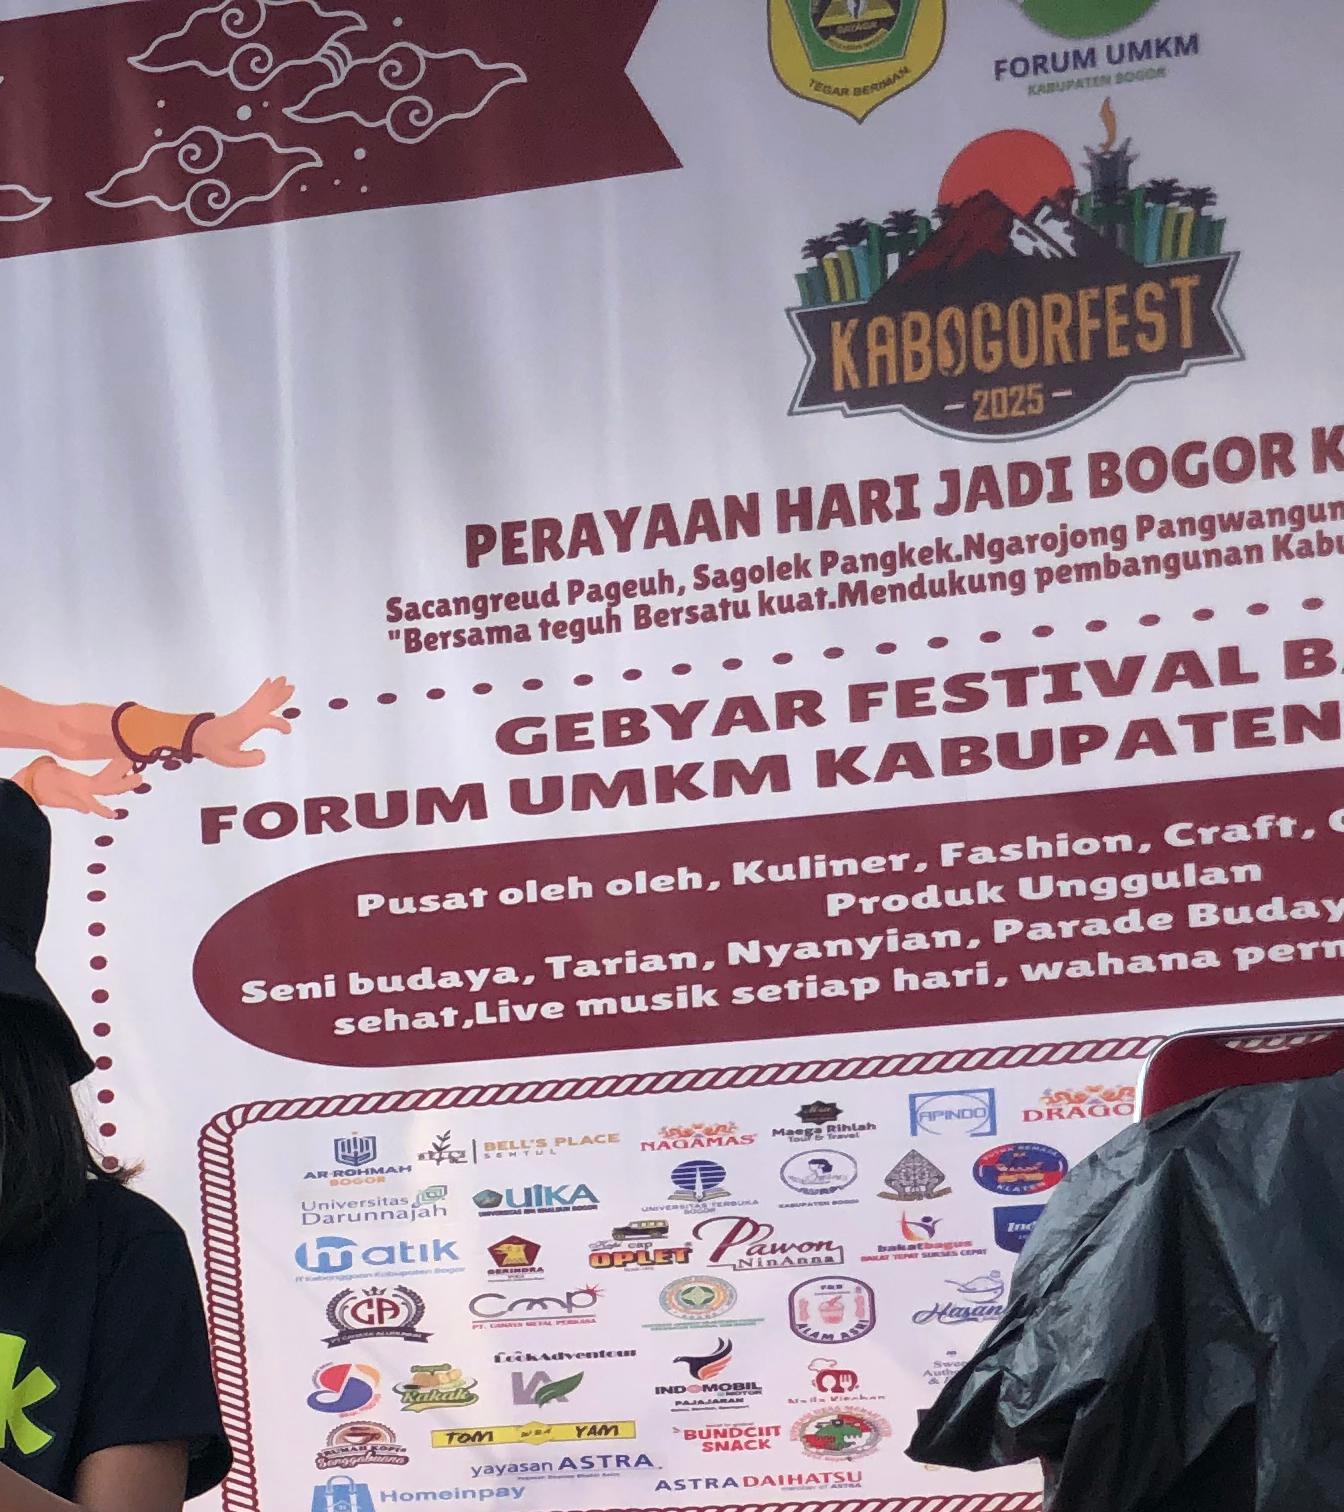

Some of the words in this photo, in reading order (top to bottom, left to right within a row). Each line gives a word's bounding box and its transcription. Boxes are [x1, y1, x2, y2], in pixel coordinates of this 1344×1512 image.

[993, 46, 1097, 81] FORUM
[1110, 33, 1200, 67] UMKM
[809, 78, 850, 97] TEGAR
[852, 66, 910, 97] BERIMAN
[1027, 76, 1110, 97] KABUPATEN
[1114, 67, 1166, 87] BOGOR
[830, 275, 1201, 392] KABOGORFEST
[972, 383, 1045, 422] 2025
[465, 492, 761, 568] PERAYAAN
[775, 473, 920, 534] HARI
[933, 456, 1073, 516] JADI
[1088, 432, 1297, 498] BOGOR
[385, 581, 558, 624] Sacangreud
[566, 568, 686, 607] Pageuh,
[693, 552, 813, 592] Sagolek
[819, 522, 1127, 578] Pangkek.Ngarojong
[388, 620, 531, 654] "Bersama
[539, 608, 622, 644] teguh
[634, 597, 752, 631] Bersatu
[758, 566, 1026, 617] kuat.Mendukung
[1034, 539, 1265, 593] pembangunan
[495, 688, 826, 756] GEBYAR
[848, 646, 1260, 723] FESTIVAL
[1283, 637, 1344, 681] B
[200, 783, 488, 845] FORUM
[510, 754, 792, 815] UMKM
[816, 700, 1343, 788] KABUPATEN
[356, 887, 488, 918] Pusat
[498, 876, 592, 907] oleh
[605, 865, 721, 897] oleh,
[732, 854, 928, 886] Kuliner,
[940, 832, 1151, 868] Fashion,
[1164, 814, 1316, 848] Craft,
[826, 881, 1006, 918] Produk
[1018, 862, 1263, 907] Unggulan
[241, 974, 336, 1005] Seni
[348, 963, 537, 998] budaya,
[545, 949, 716, 982] Tarian,
[727, 928, 982, 968] Nyanyian,
[993, 910, 1174, 945] Parade
[333, 1000, 563, 1037] sehat,Live
[577, 986, 720, 1018] musik
[731, 975, 881, 1006] setiap
[893, 961, 1008, 994] hari,
[1020, 947, 1222, 985] wahana
[919, 1107, 987, 1122] APINDO
[1022, 1103, 1135, 1123] DRAGO
[483, 1137, 548, 1152] BELL'S
[554, 1132, 621, 1148] PLACE
[301, 1196, 409, 1212] Universitas
[301, 1204, 447, 1226] Darunnajah
[692, 1216, 835, 1263] Pawon
[589, 1247, 693, 1269] OPLET
[446, 1430, 494, 1444] TOM
[575, 1425, 620, 1438] YAM
[702, 1439, 772, 1453] SNACK
[470, 1460, 553, 1478] yayasan
[558, 1453, 655, 1471] ASTRA
[654, 1476, 739, 1491] ASTRA
[743, 1471, 863, 1488] DAIHATSU
[380, 1485, 527, 1503] Homeinpay
